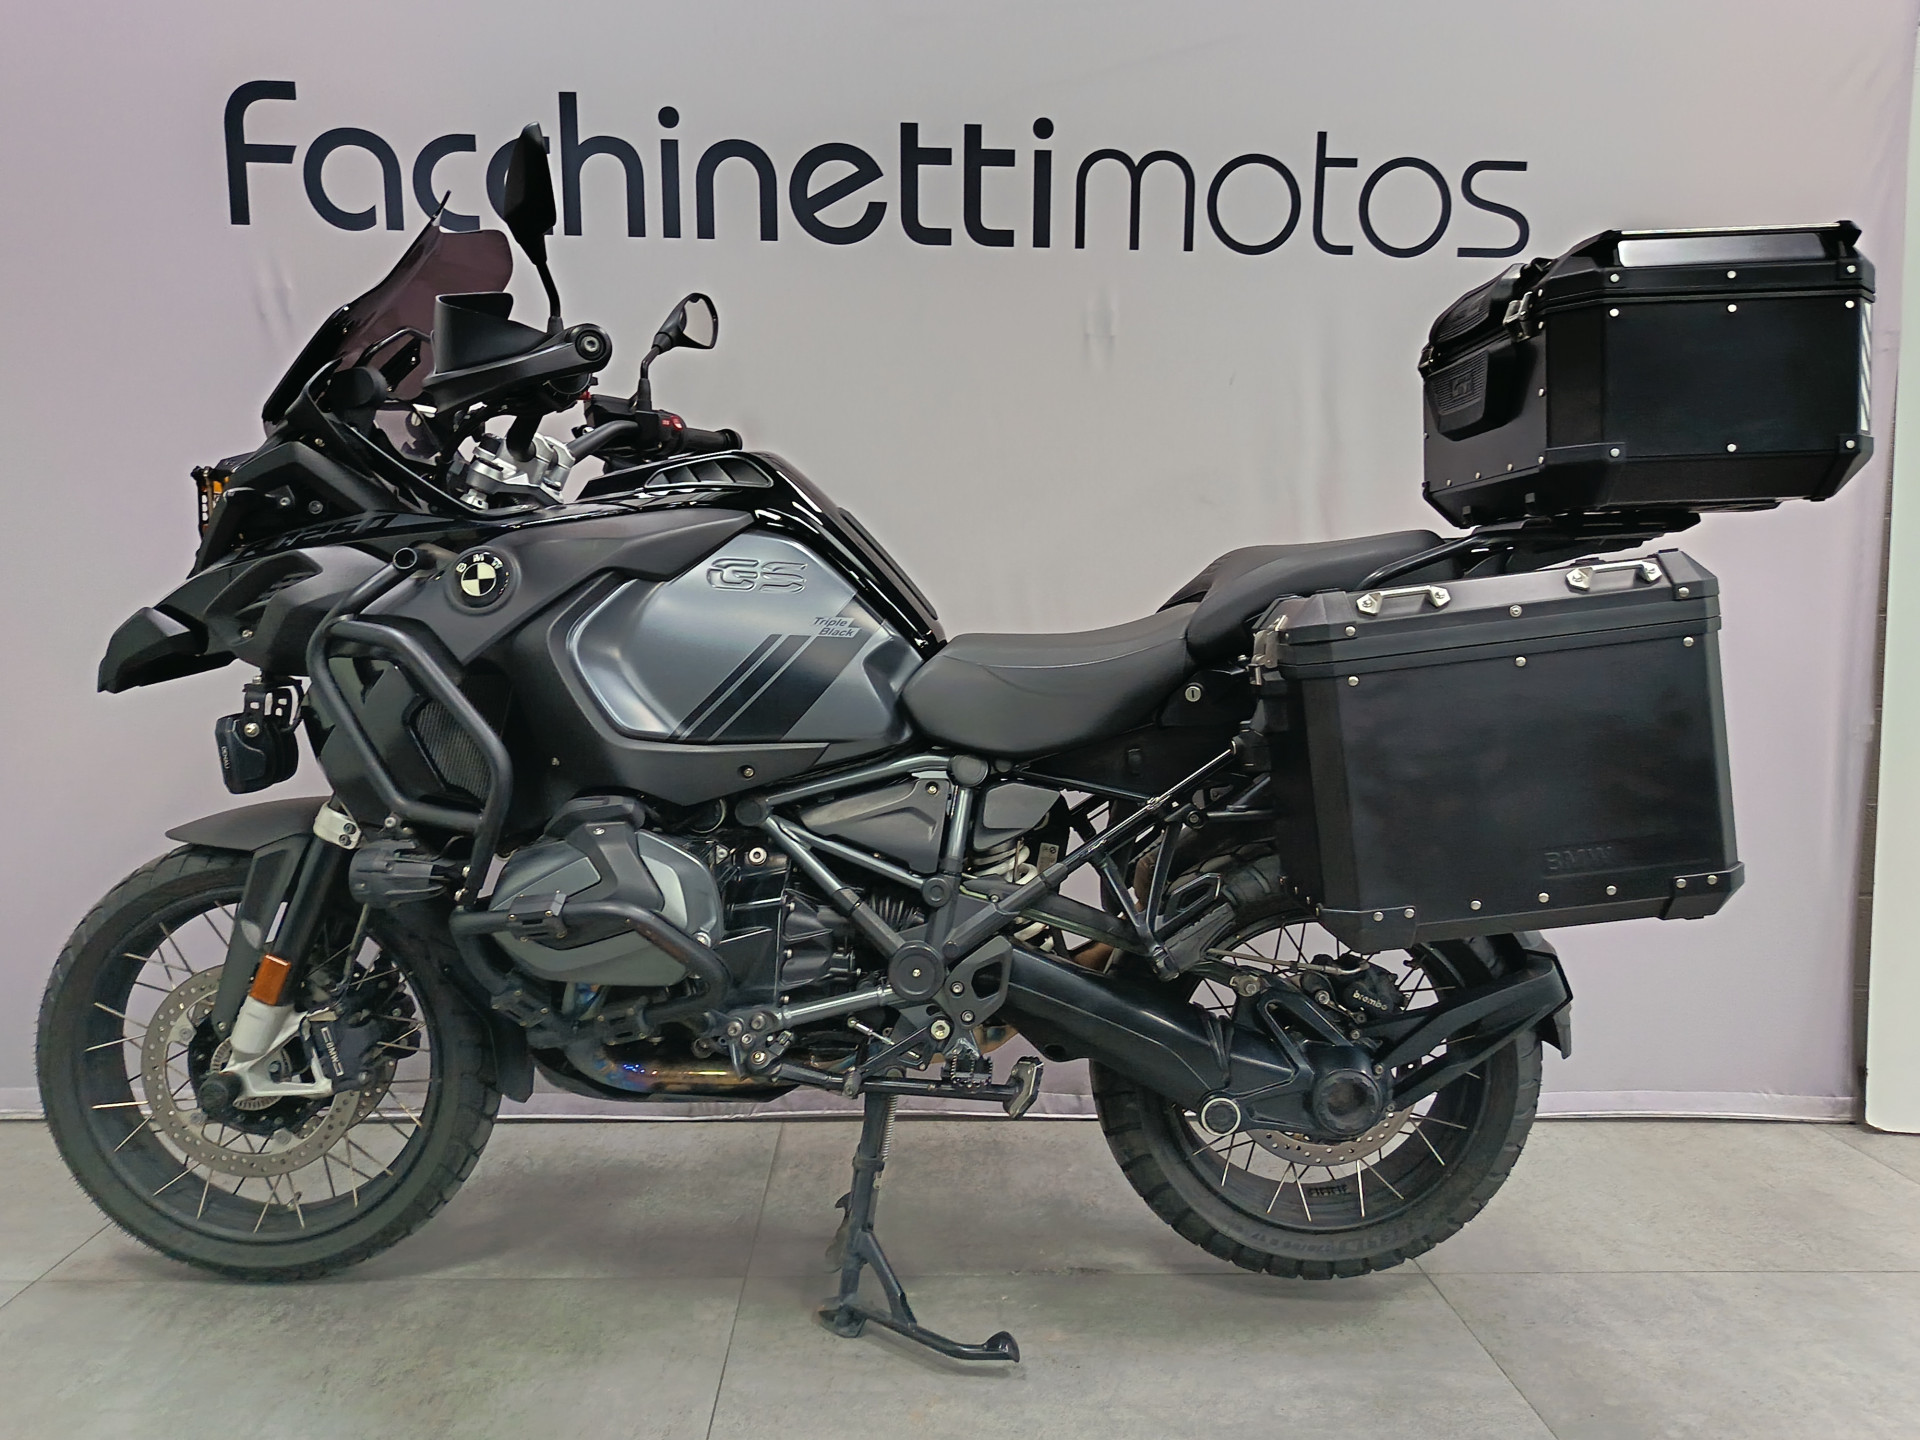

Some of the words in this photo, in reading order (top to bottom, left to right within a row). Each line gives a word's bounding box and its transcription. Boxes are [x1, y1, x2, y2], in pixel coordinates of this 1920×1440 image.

[455, 553, 504, 573] BMW
[706, 557, 808, 594] GS
[813, 616, 849, 628] Triple
[818, 626, 856, 637] Black
[1352, 990, 1388, 1011] brembo
